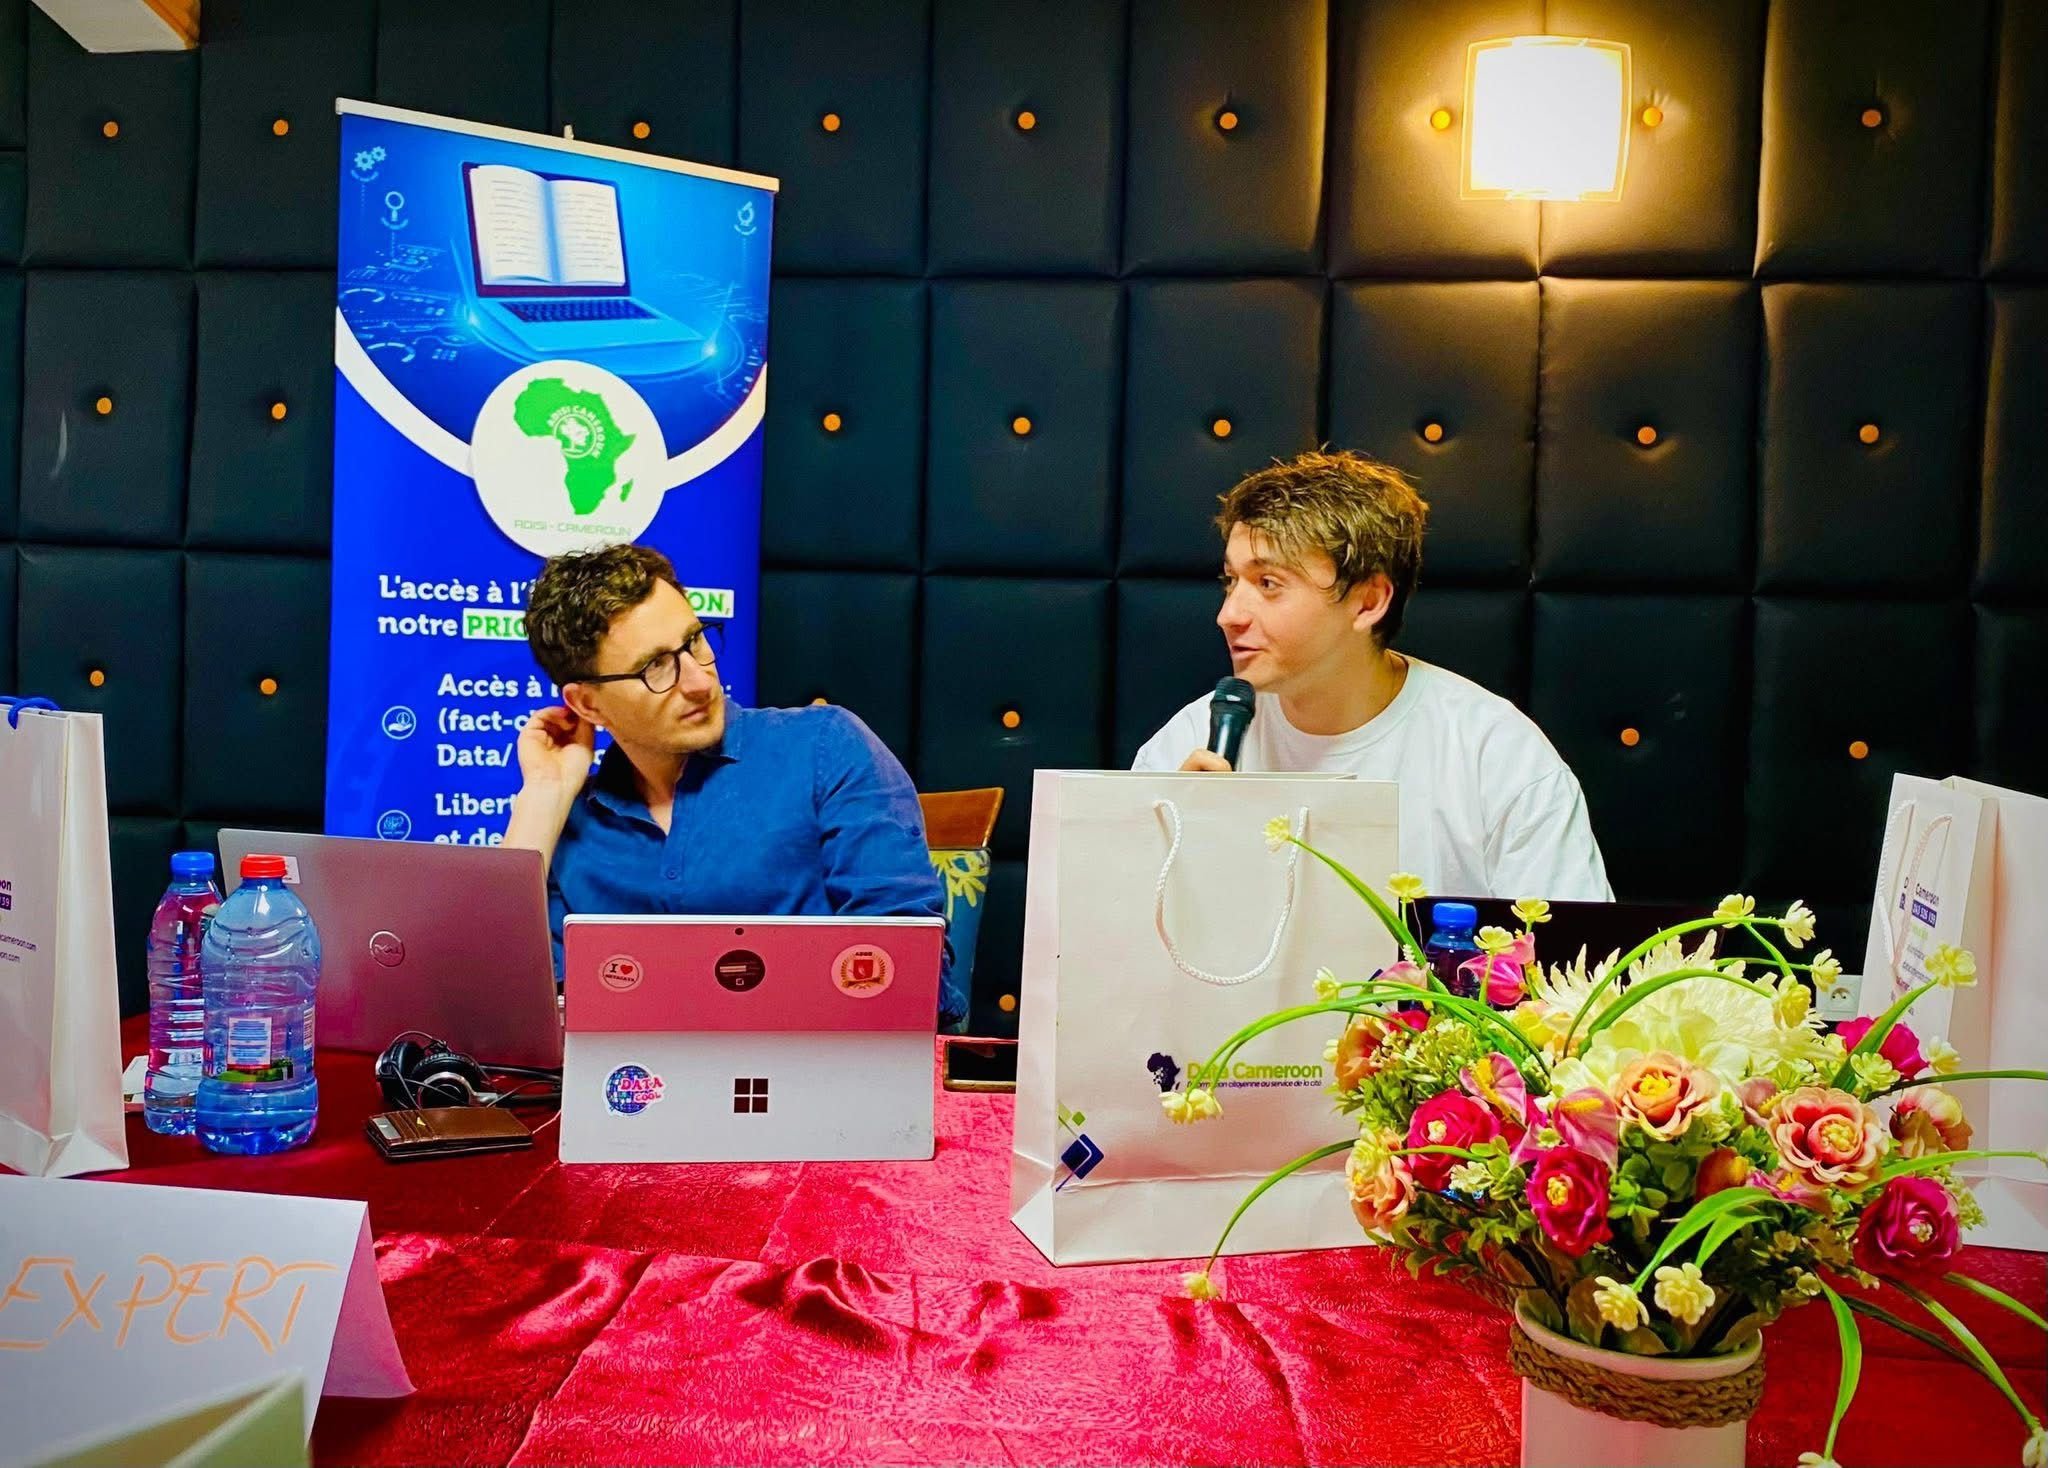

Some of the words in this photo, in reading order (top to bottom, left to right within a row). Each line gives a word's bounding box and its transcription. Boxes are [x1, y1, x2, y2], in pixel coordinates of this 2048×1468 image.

[378, 574, 480, 602] L'accès
[486, 580, 504, 604] à
[377, 613, 458, 637] notre
[466, 615, 528, 638] PRIO
[437, 673, 520, 698] Accès
[526, 675, 543, 698] à
[438, 707, 537, 734] (fact-c
[437, 742, 514, 769] Data/
[435, 792, 518, 816] Libert
[0, 879, 12, 891] on
[1233, 1061, 1323, 1080] Cameroon
[620, 1077, 664, 1091] DATA
[635, 1091, 662, 1102] COOL
[0, 1253, 338, 1355] EXPERT
